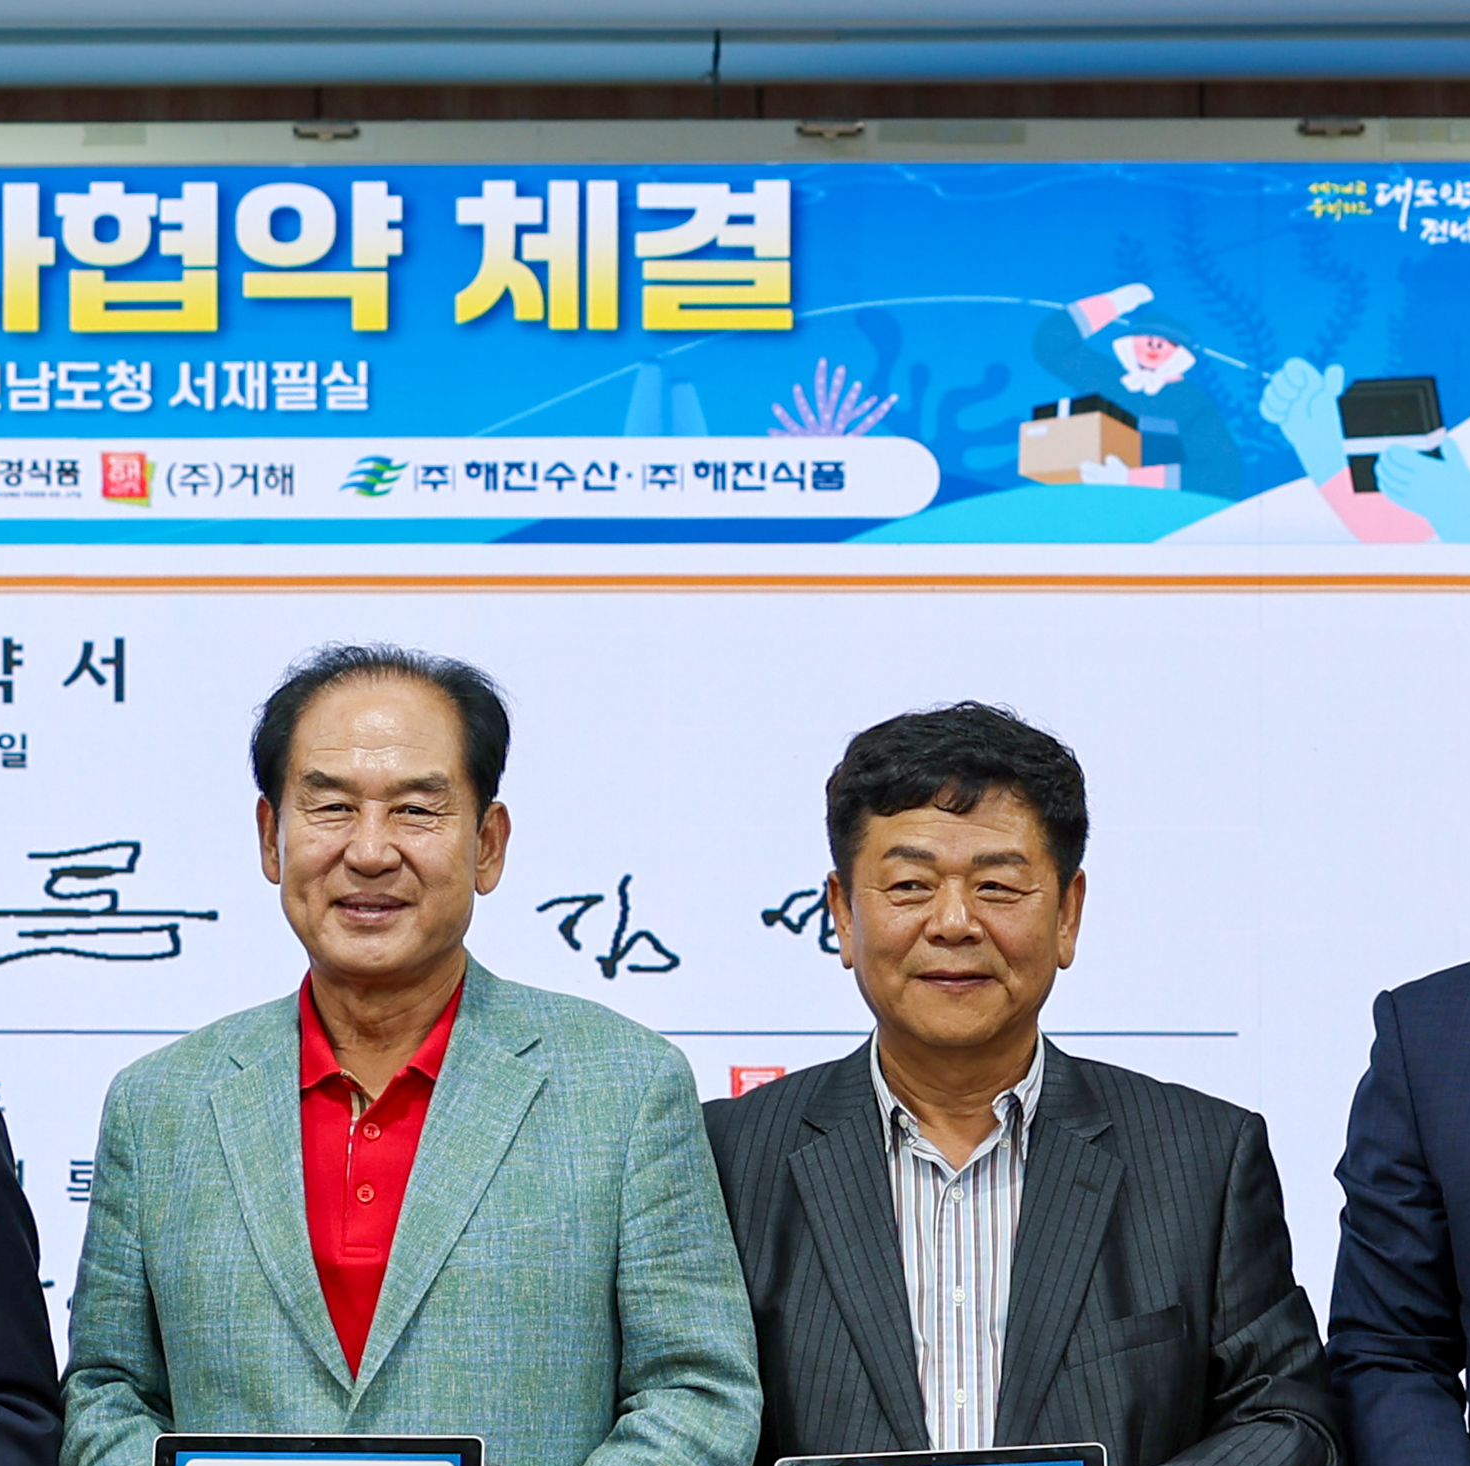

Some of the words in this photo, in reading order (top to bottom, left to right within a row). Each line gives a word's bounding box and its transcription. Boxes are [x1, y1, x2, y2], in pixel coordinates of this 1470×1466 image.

[454, 179, 794, 330] 체결
[168, 360, 368, 410] 서재필실
[166, 463, 293, 495] (주)거해
[692, 461, 847, 491] 해진식품
